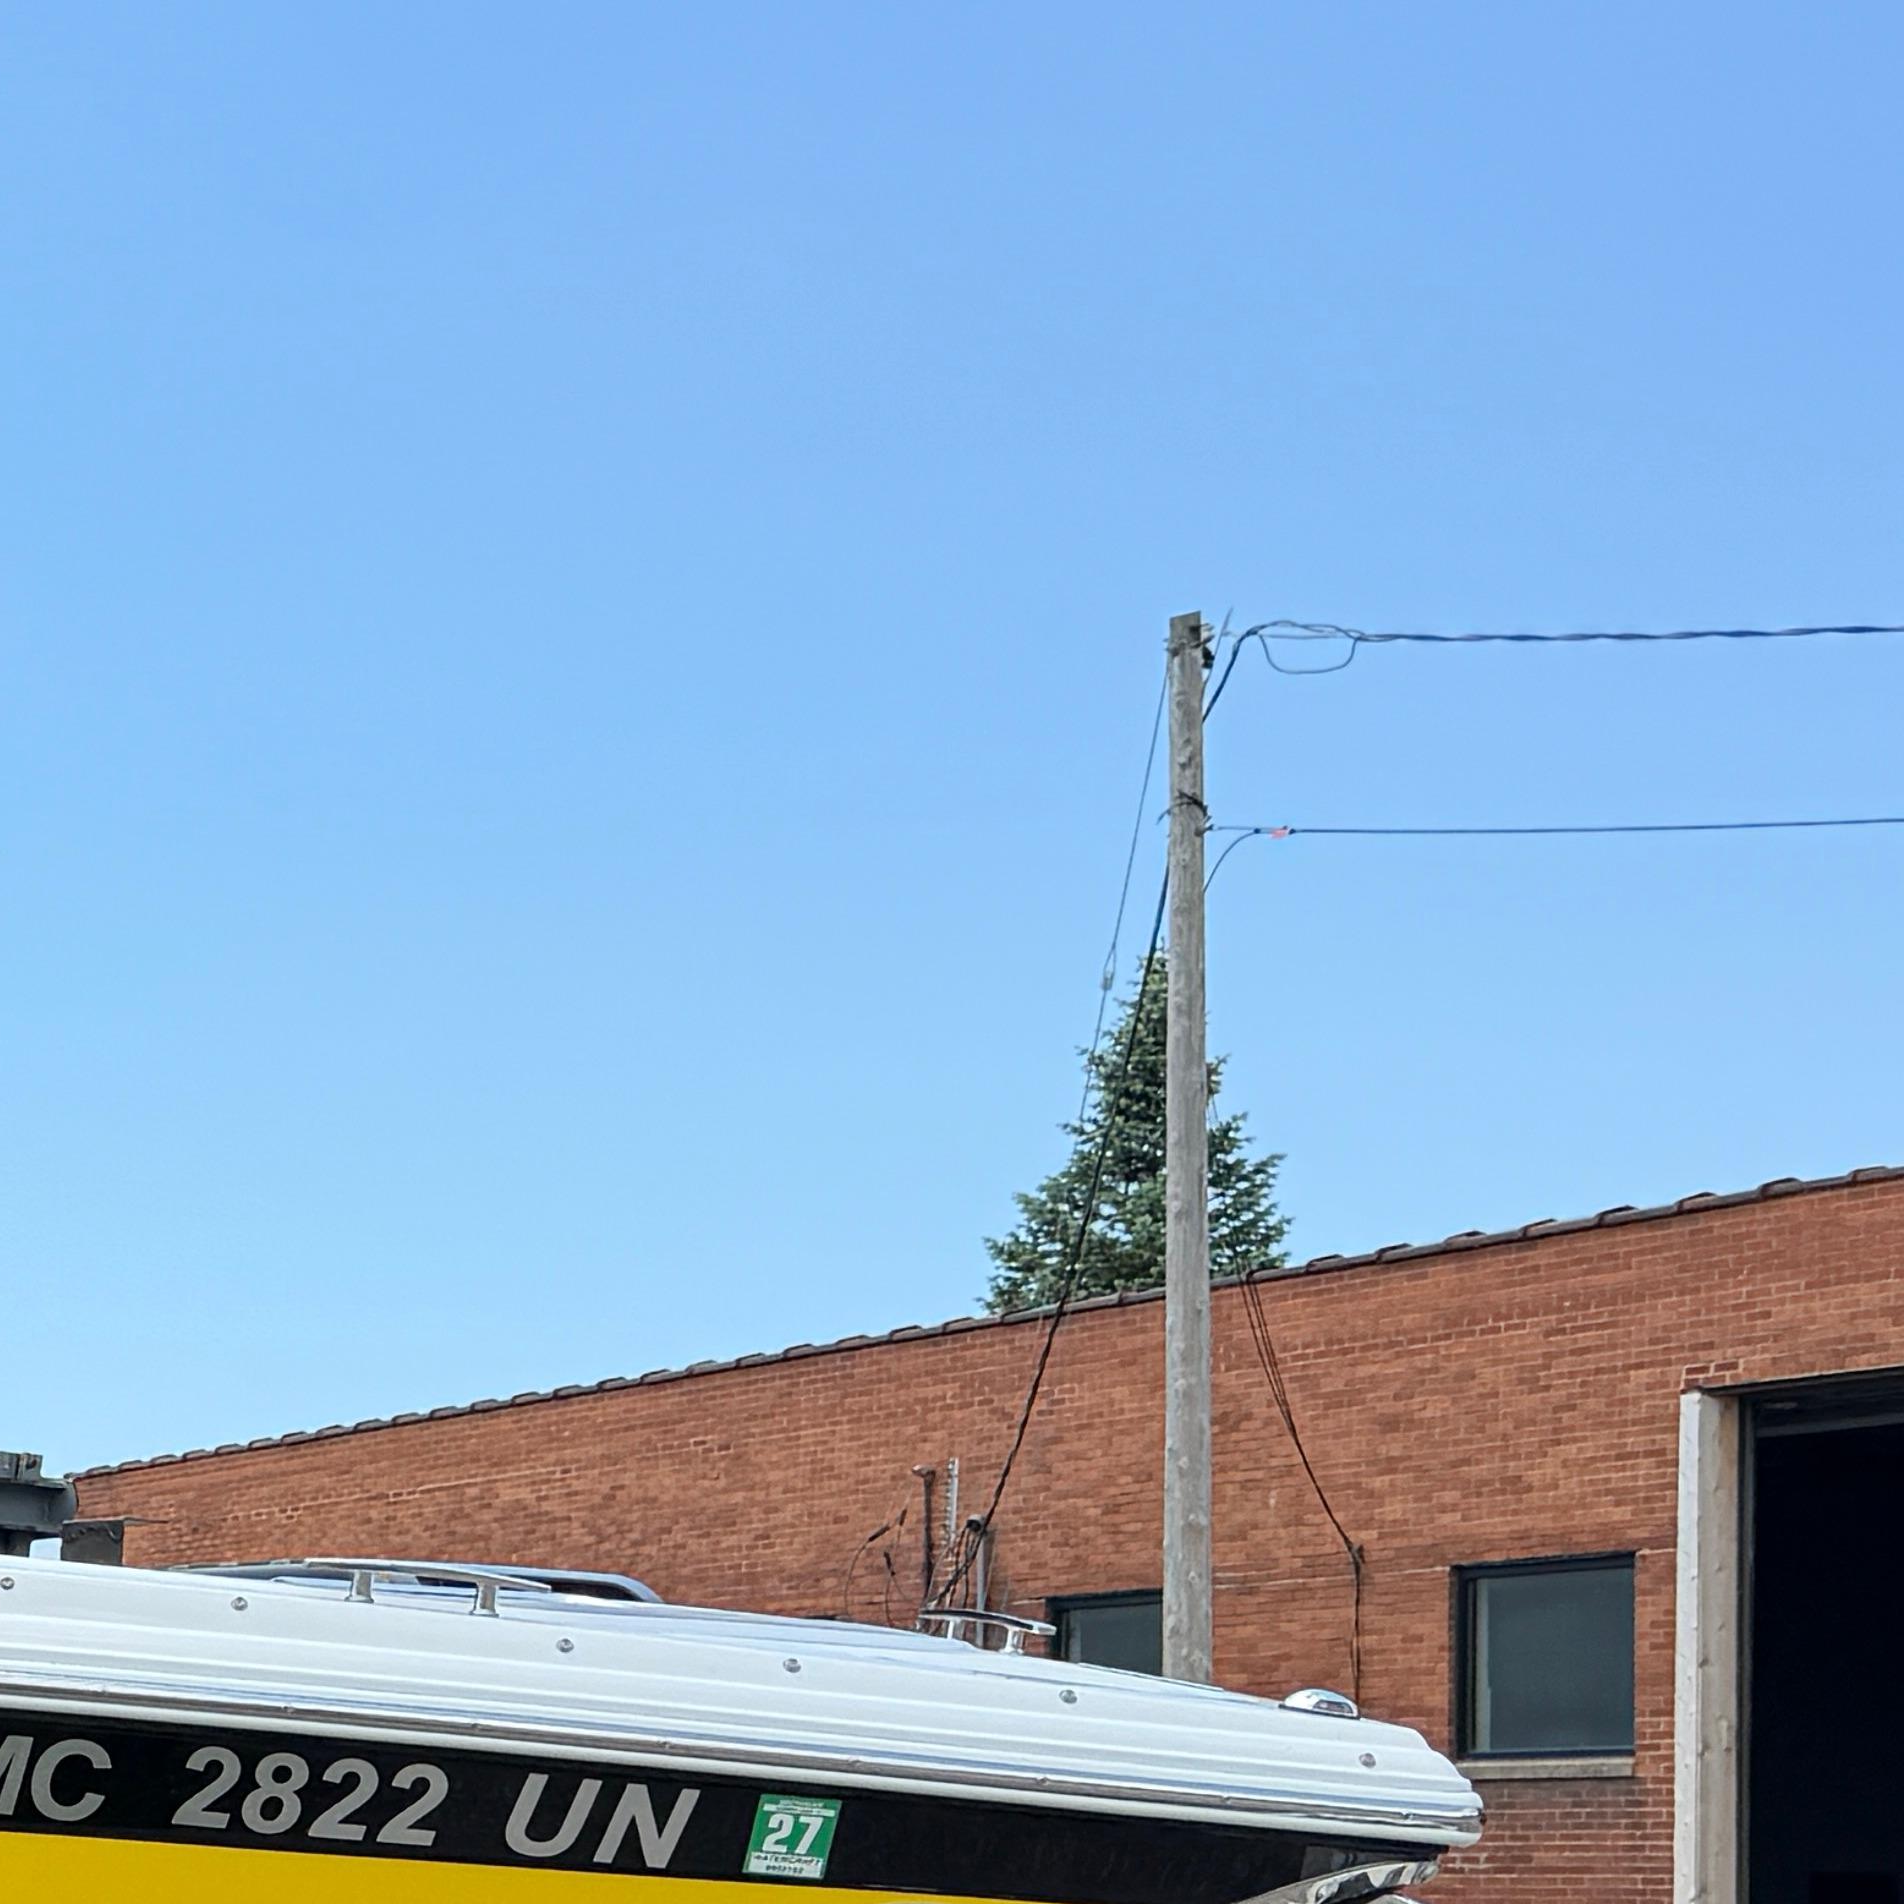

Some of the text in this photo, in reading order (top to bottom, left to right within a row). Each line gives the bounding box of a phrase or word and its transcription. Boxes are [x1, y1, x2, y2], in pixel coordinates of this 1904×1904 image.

[171, 1746, 449, 1847] 2822
[505, 1772, 701, 1869] UN
[761, 1812, 825, 1855] 27
